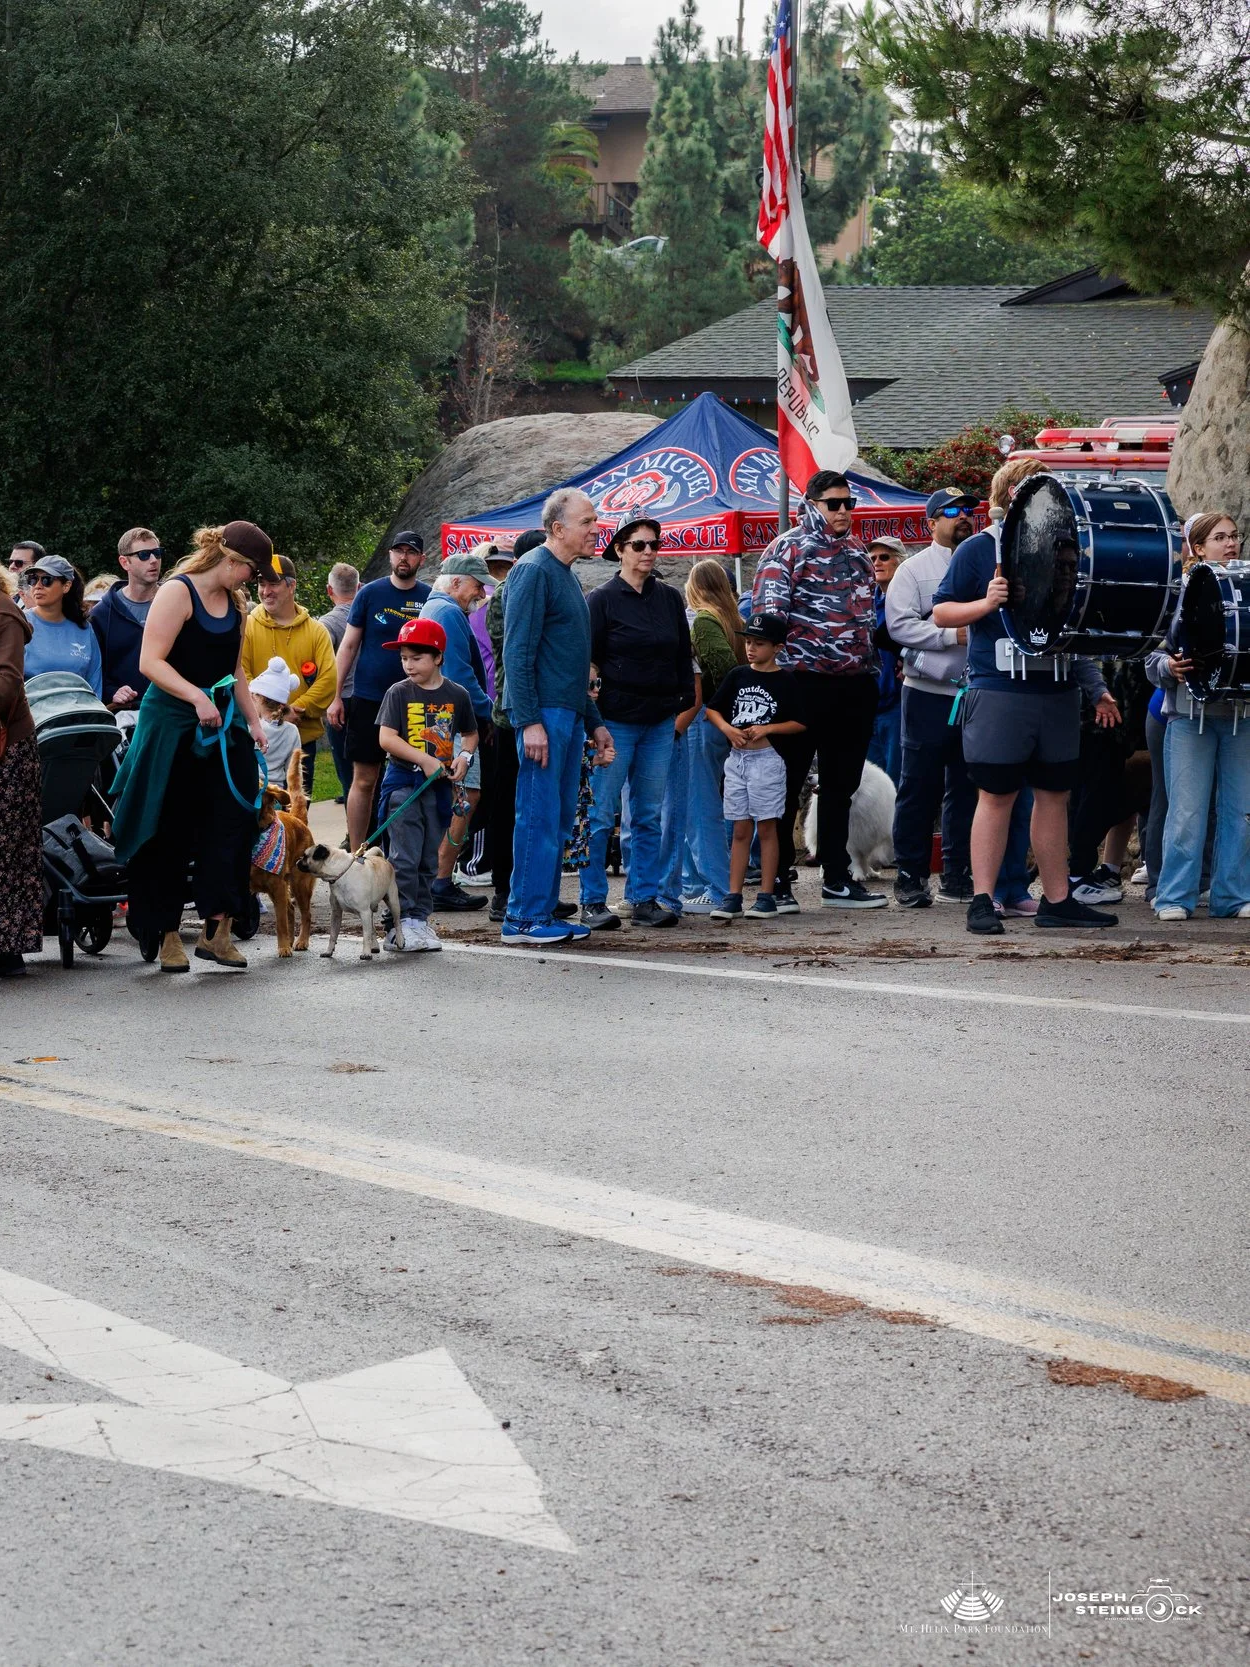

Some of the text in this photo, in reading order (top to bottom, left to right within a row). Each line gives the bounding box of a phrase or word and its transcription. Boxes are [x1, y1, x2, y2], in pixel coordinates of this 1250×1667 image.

[589, 464, 631, 495] AN
[635, 452, 711, 498] MIGUEL
[736, 462, 762, 495] SAN
[658, 523, 729, 549] ESCUE
[861, 517, 901, 541] FIRE
[902, 516, 918, 539] &
[764, 580, 778, 615] Pacif
[738, 685, 774, 702] Outdoor
